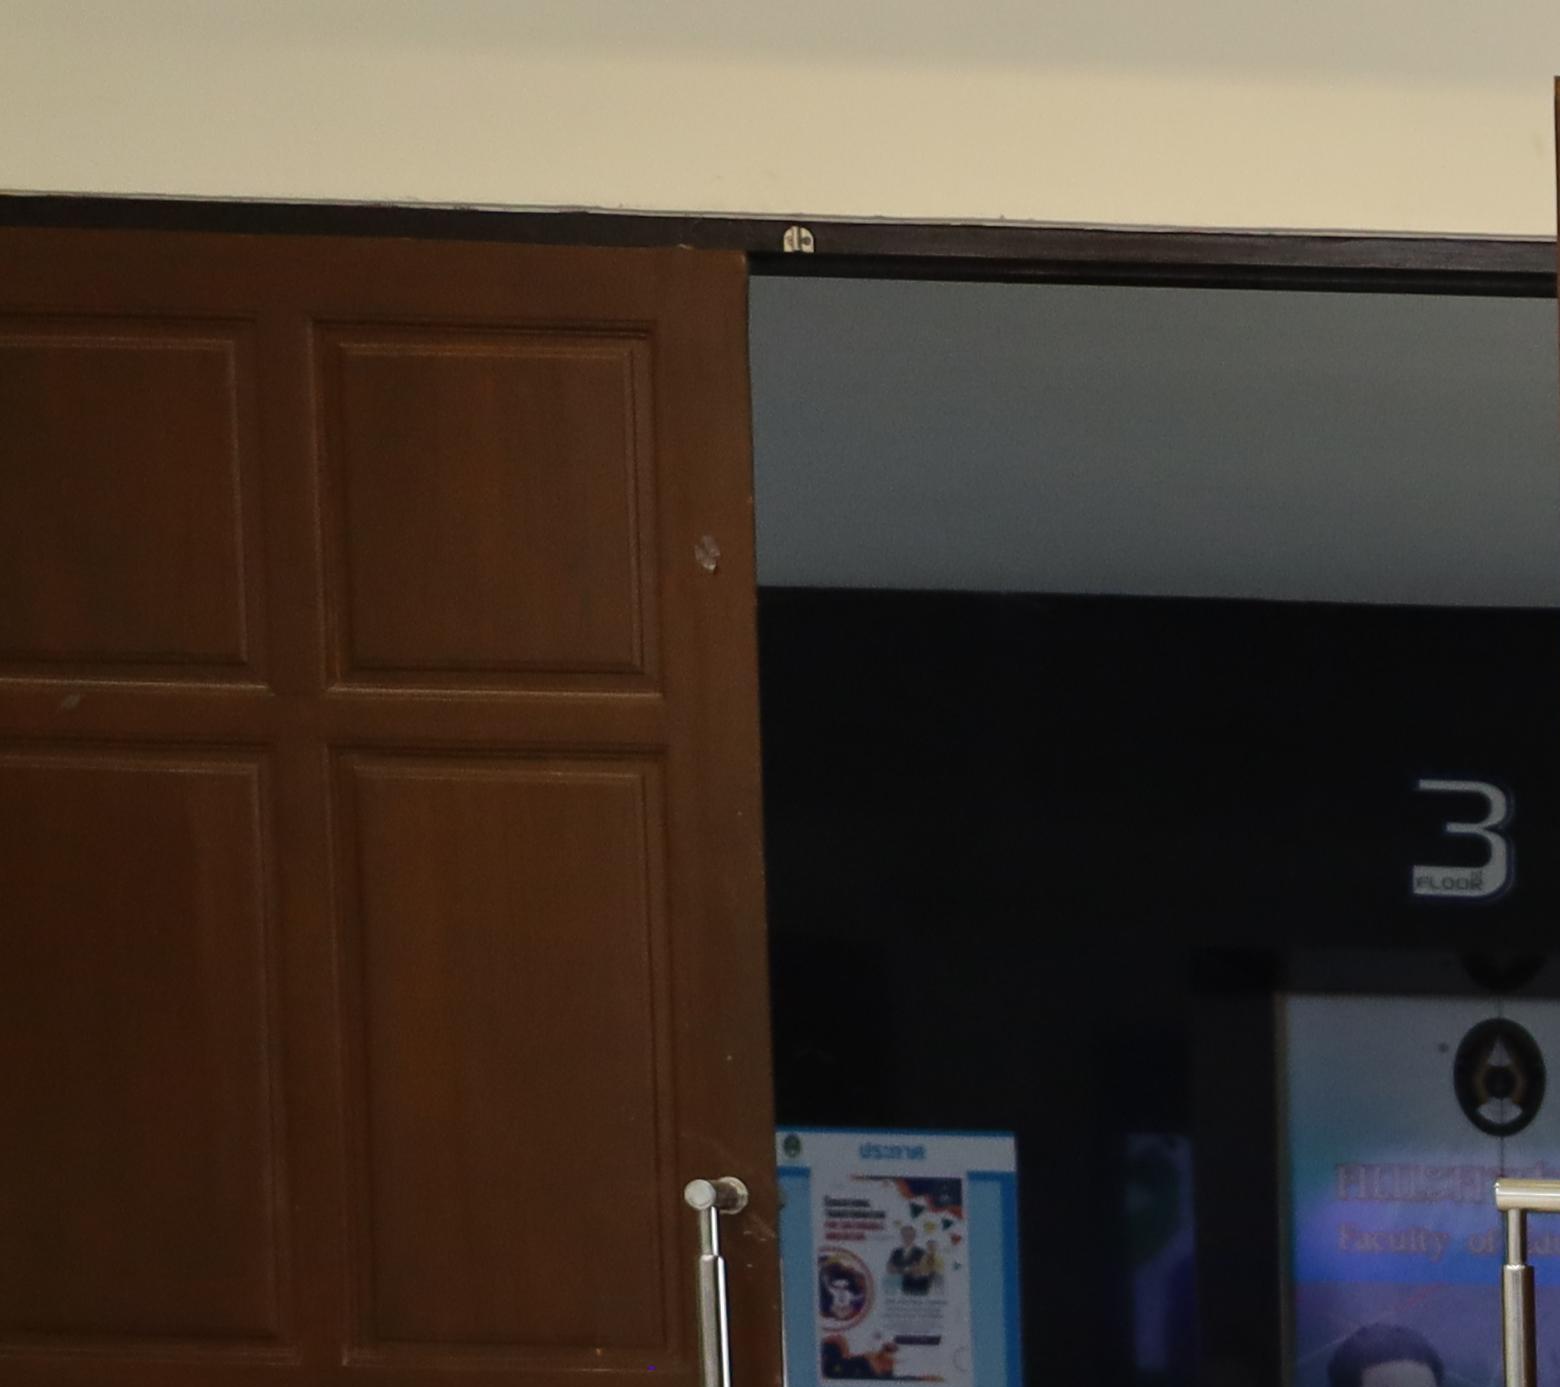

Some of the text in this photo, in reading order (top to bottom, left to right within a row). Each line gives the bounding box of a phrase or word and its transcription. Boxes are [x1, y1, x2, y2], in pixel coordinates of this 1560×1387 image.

[1412, 778, 1508, 897] 3
[1338, 1224, 1449, 1263] Faculty
[1467, 1227, 1499, 1256] of
